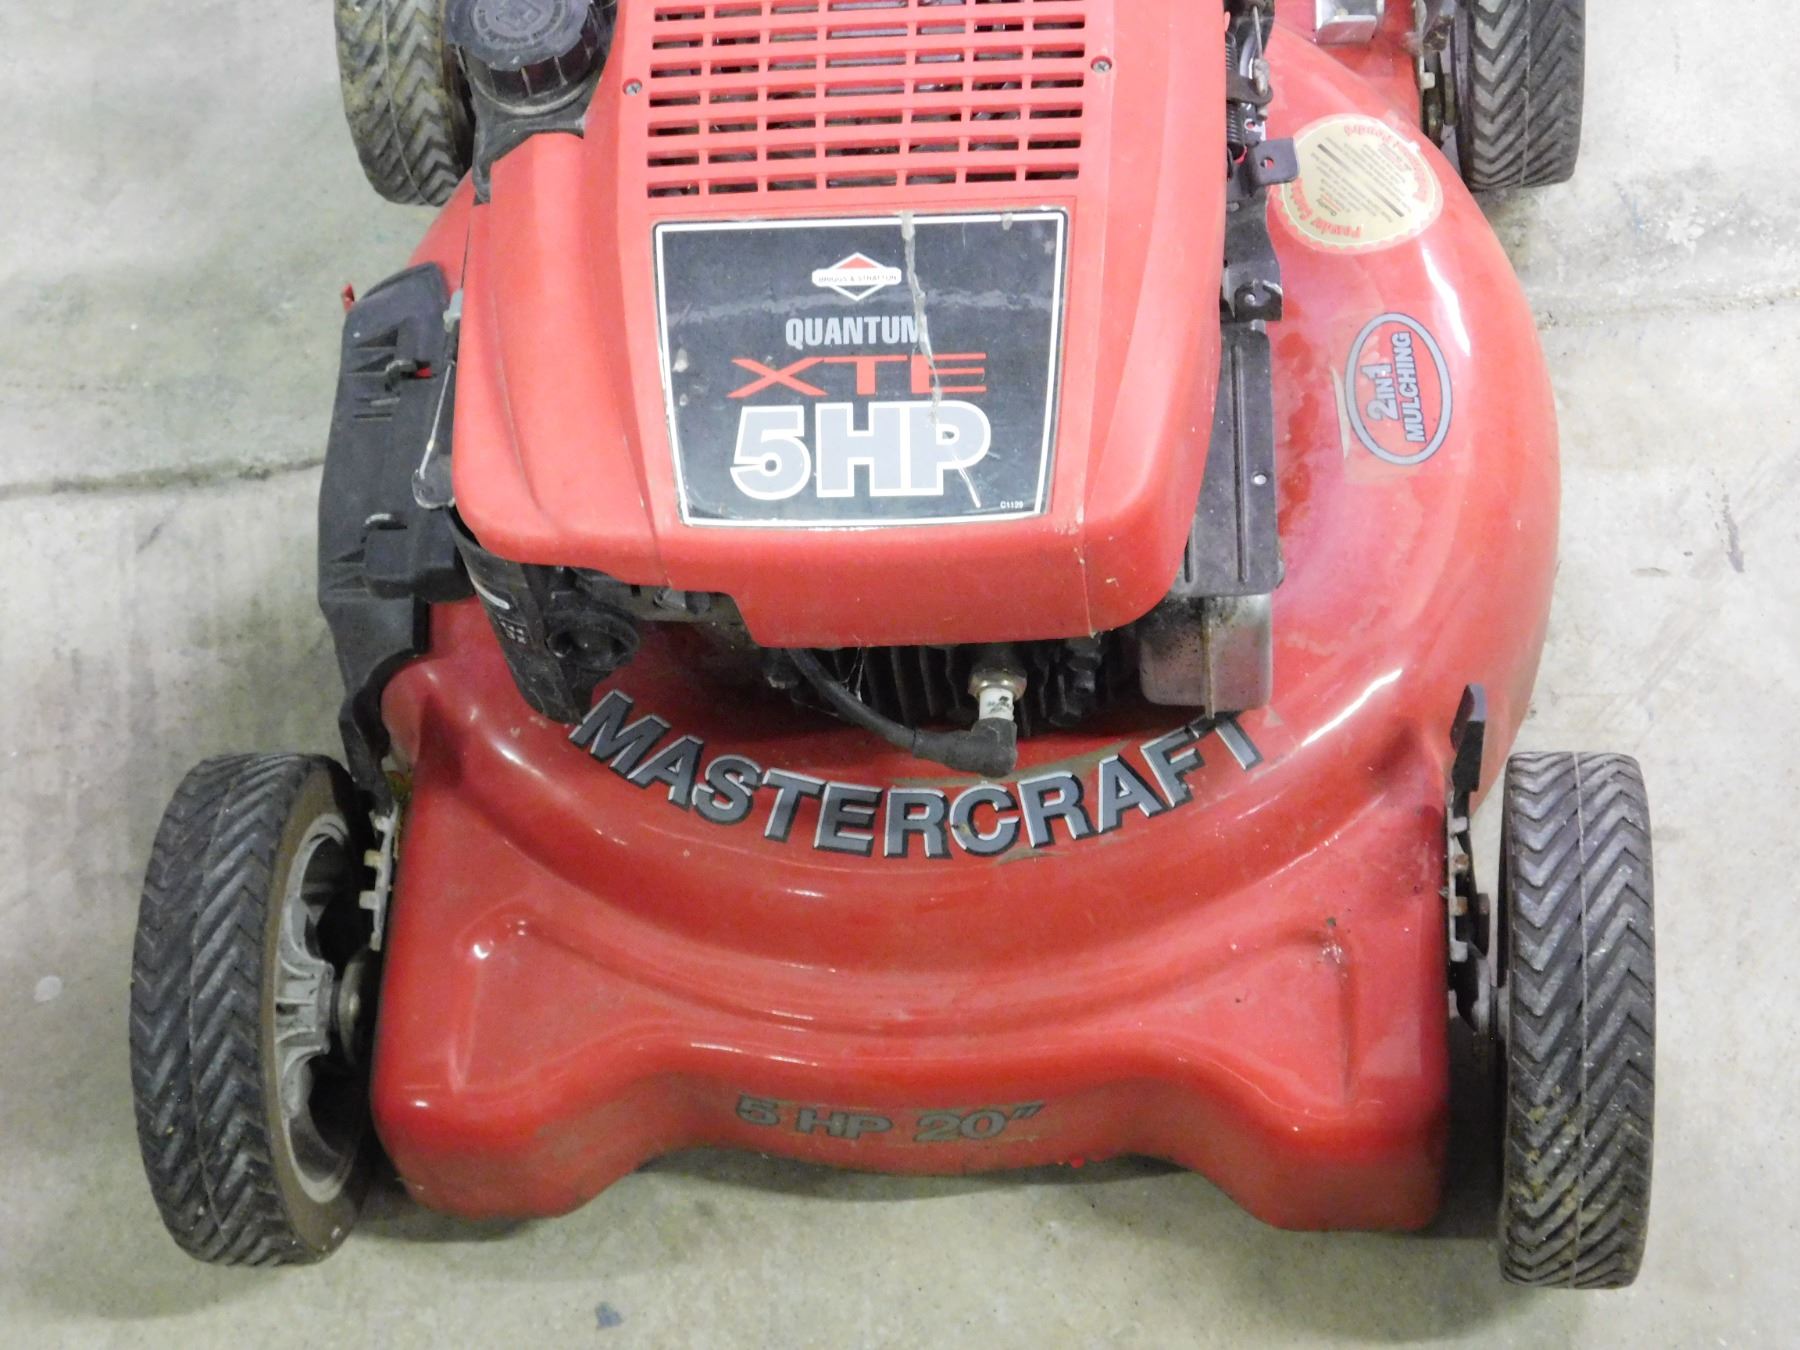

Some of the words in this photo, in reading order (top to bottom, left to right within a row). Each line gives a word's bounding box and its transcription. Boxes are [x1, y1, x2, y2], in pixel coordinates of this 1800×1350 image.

[785, 315, 927, 350] QUANTUM
[726, 352, 987, 399] XTE
[1391, 330, 1427, 443] MULCHING
[730, 400, 991, 500] 5HP
[568, 688, 1262, 860] MASTERCRAFT
[736, 1094, 780, 1126] 5
[795, 1108, 892, 1140] HP
